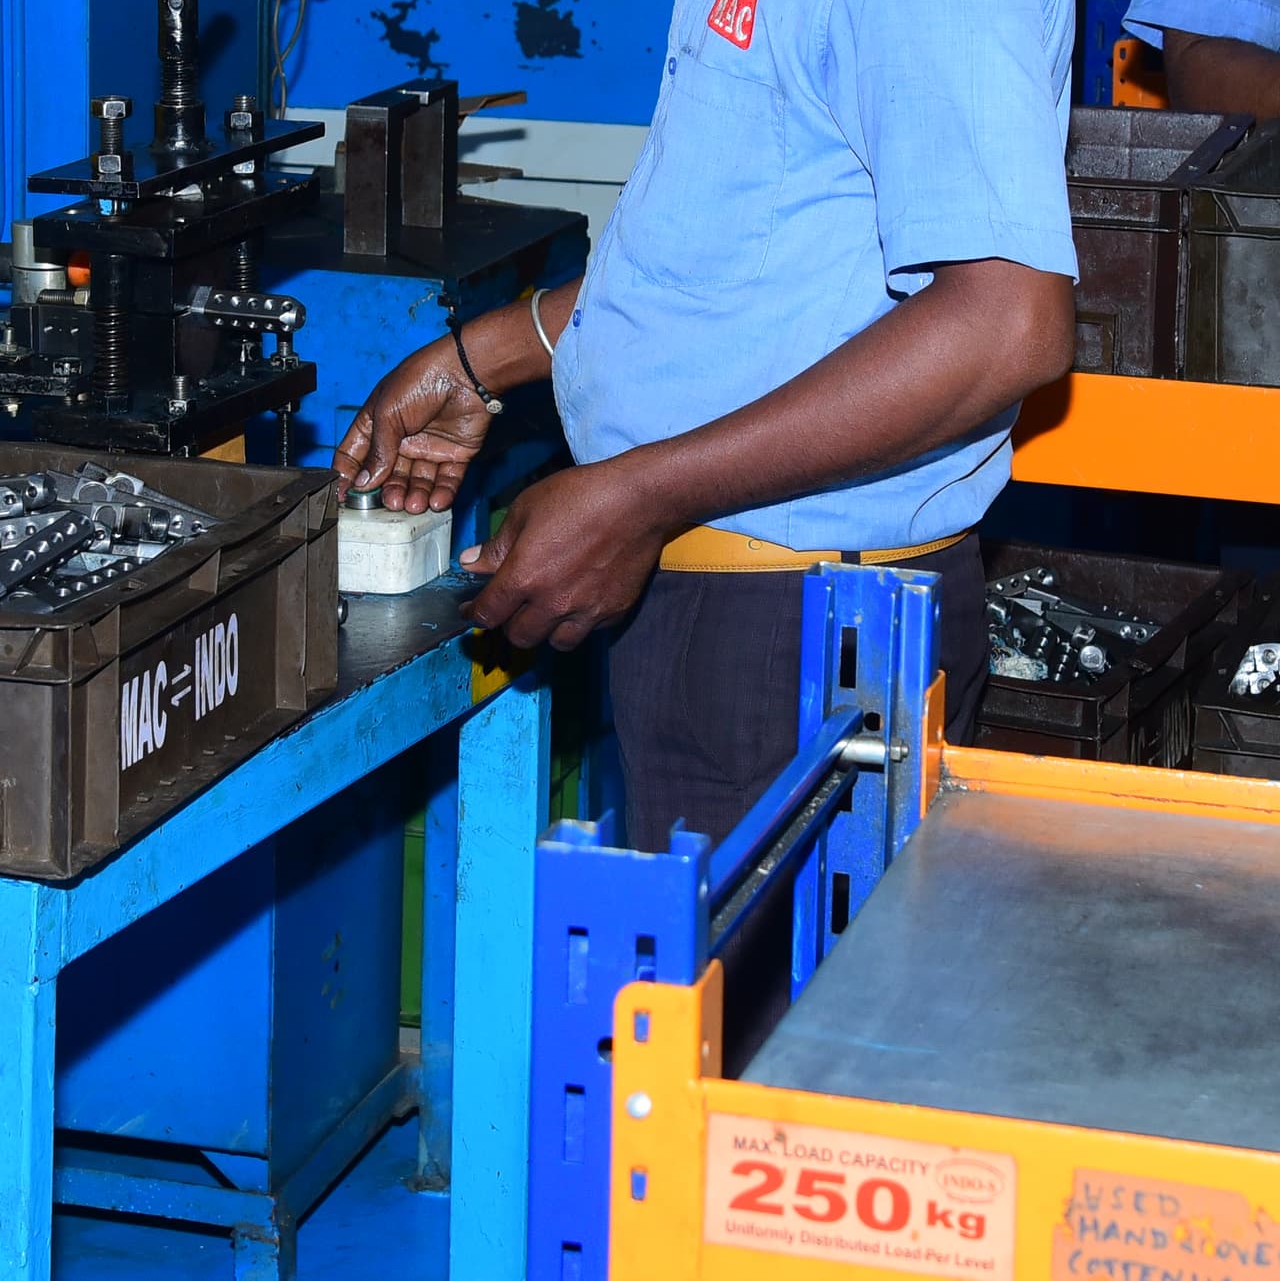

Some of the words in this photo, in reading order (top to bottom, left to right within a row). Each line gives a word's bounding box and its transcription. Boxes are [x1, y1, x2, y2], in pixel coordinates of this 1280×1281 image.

[121, 660, 168, 772] MAC
[195, 612, 239, 722] INDO
[782, 1136, 833, 1162] LOAD
[838, 1149, 930, 1177] CAPACITY
[728, 1158, 912, 1234] 250
[926, 1199, 986, 1241] kg
[1083, 1181, 1182, 1218] USED
[724, 1218, 795, 1245] Uniformly
[799, 1229, 881, 1255] Distributed
[883, 1241, 922, 1261] Load
[924, 1247, 951, 1264] Per
[954, 1253, 995, 1271] Level
[1078, 1214, 1169, 1251] HAND
